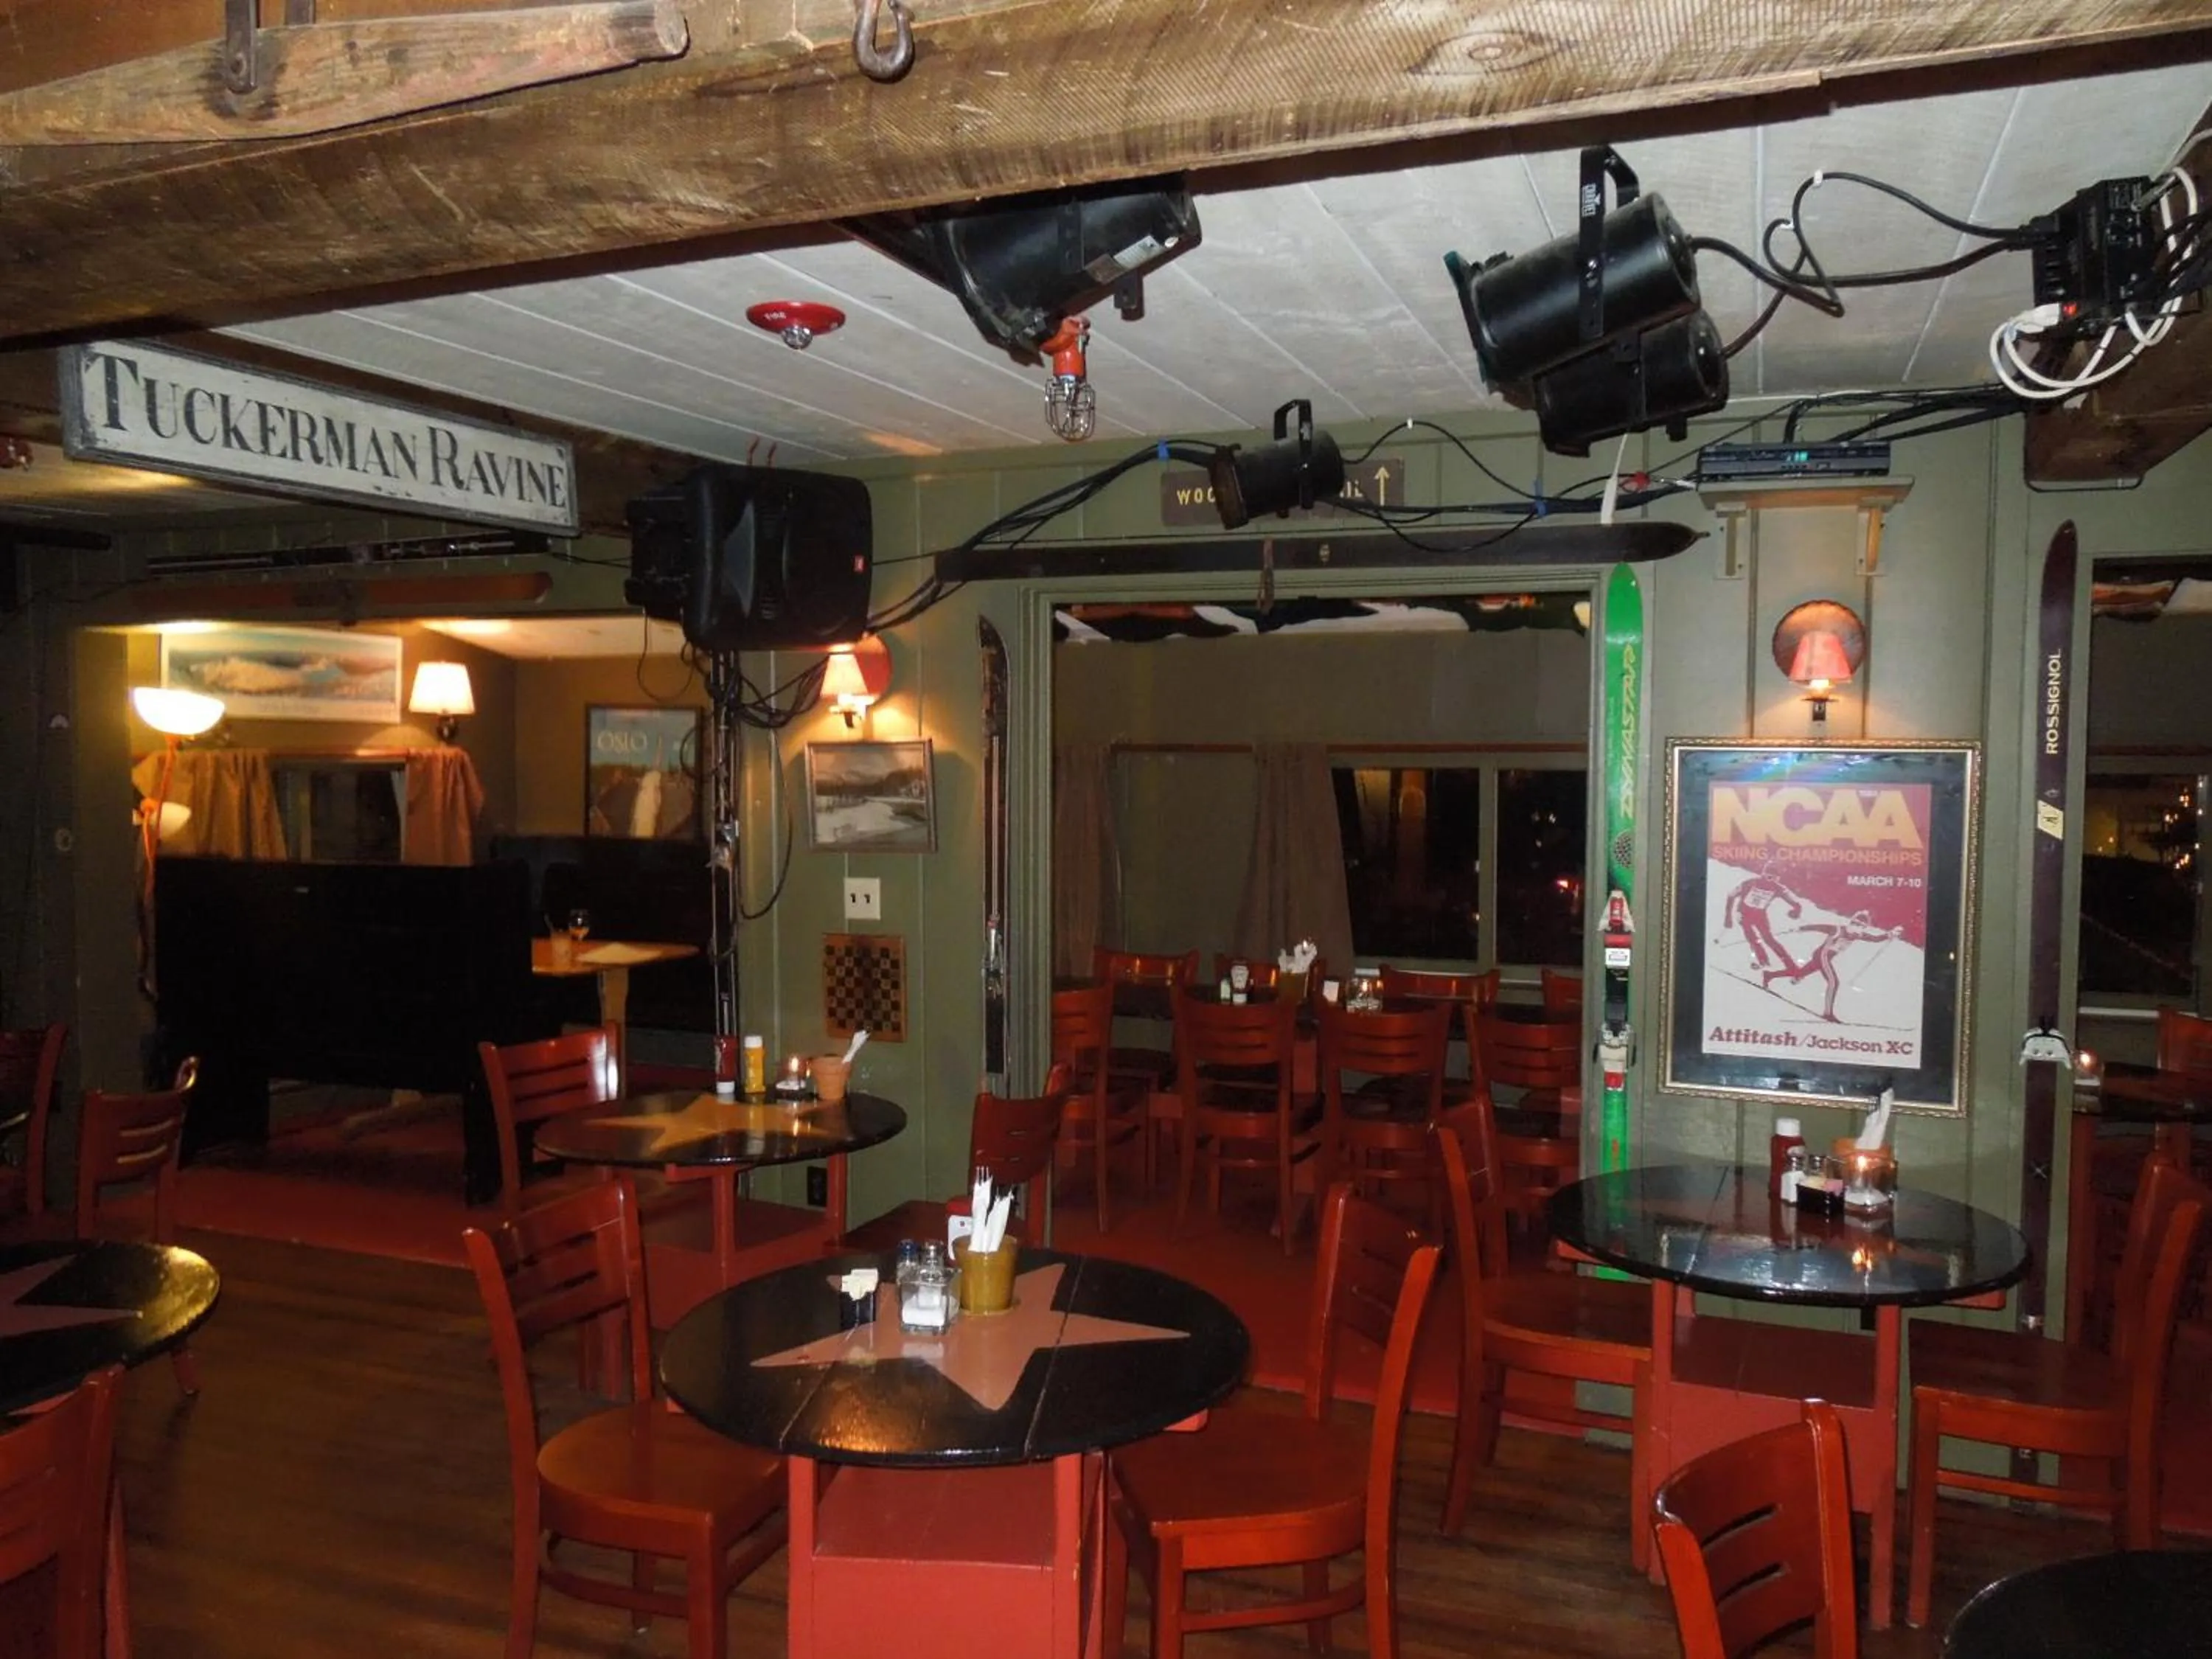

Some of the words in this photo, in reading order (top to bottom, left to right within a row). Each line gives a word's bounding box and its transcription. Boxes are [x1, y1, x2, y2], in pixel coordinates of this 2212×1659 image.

[83, 351, 418, 481] TUCKERMAN
[427, 425, 566, 507] RAVINE
[2045, 648, 2062, 755] ROSSIGNOL
[1711, 786, 1924, 849] NCAA
[1713, 846, 1768, 860] SKIING
[1776, 847, 1922, 866] CHAMPIONSHIPS
[1847, 875, 1893, 886] MARCH
[1896, 877, 1921, 888] 7-10
